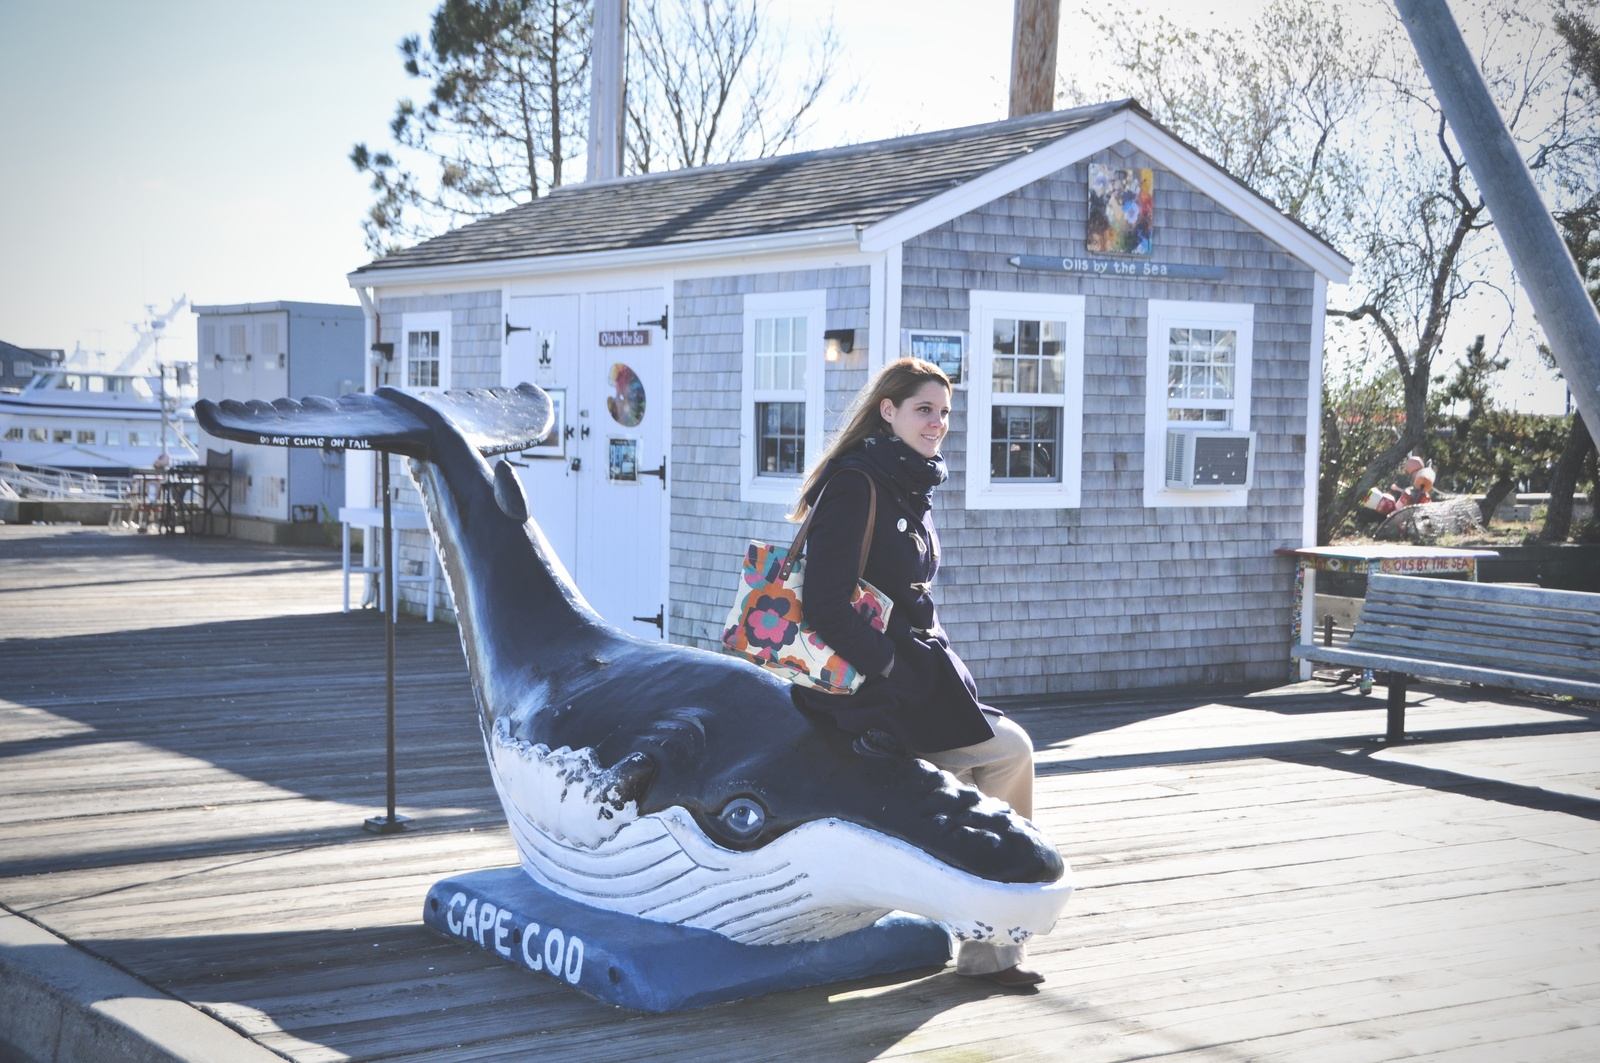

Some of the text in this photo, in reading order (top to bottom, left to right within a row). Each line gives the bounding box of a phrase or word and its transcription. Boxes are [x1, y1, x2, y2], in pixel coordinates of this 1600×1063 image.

[1062, 258, 1168, 276] Oils by the Sea
[272, 436, 289, 446] NOT
[293, 437, 325, 447] CLIMB
[330, 438, 345, 448] ON
[348, 439, 371, 449] TAIL
[1393, 557, 1469, 572] OILS BY THE SEA
[446, 892, 584, 985] CAPE COD
